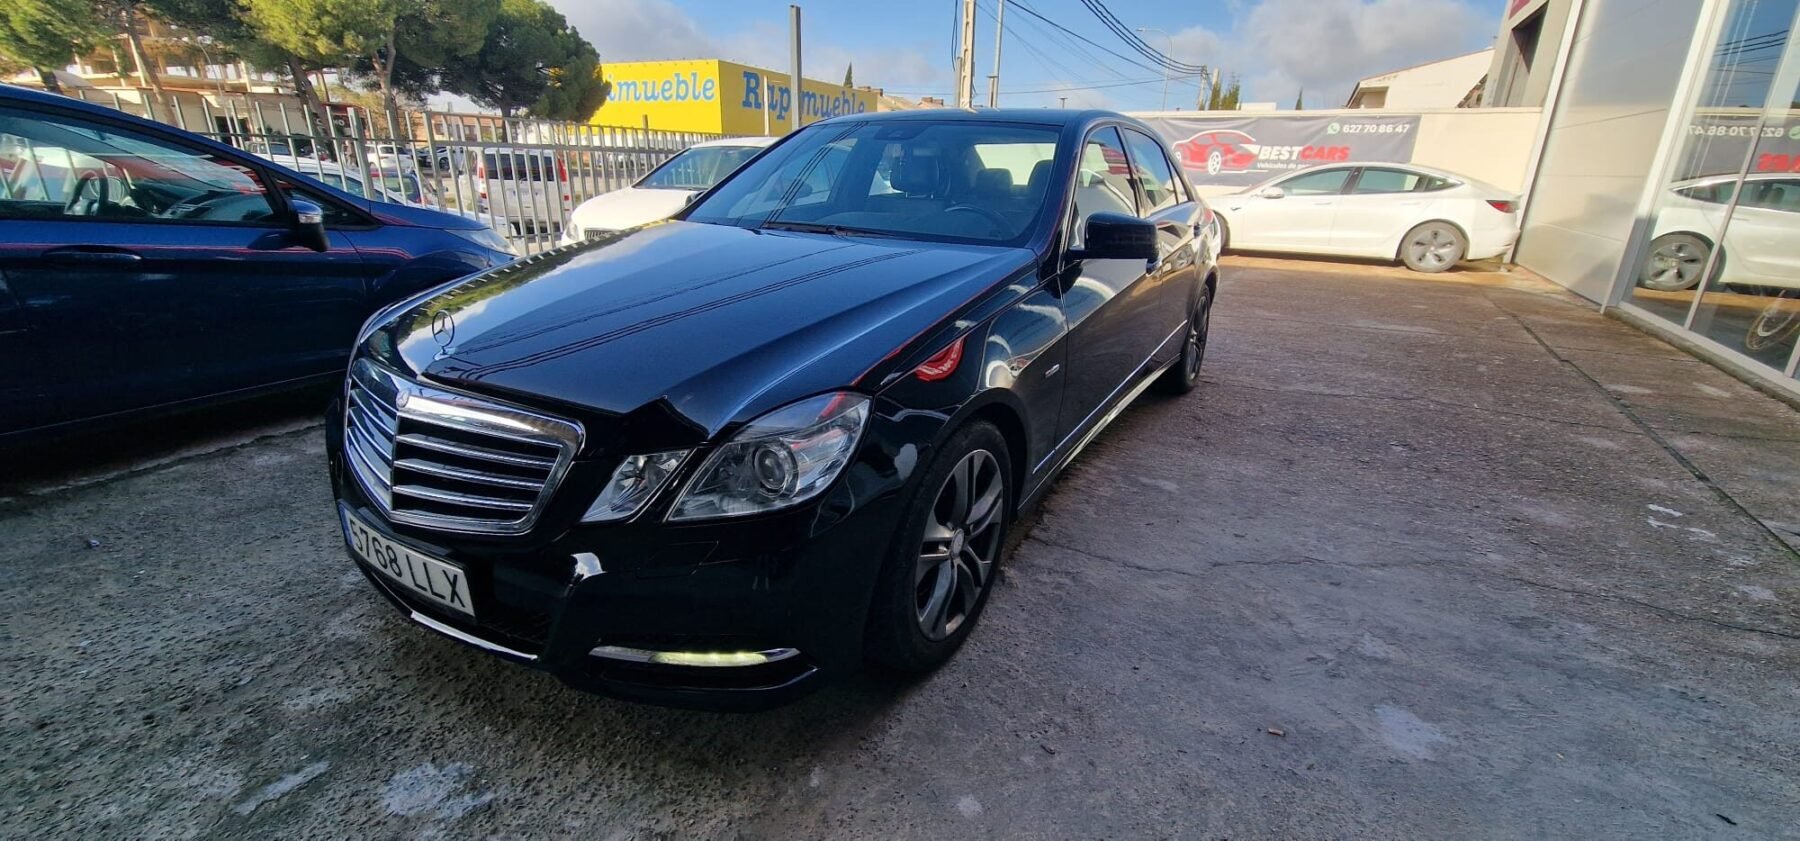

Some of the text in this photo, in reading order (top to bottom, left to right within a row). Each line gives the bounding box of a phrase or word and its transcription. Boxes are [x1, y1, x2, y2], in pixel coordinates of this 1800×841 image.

[1342, 124, 1361, 134] 627
[1363, 124, 1377, 134] 70
[1395, 123, 1411, 134] 47
[1258, 145, 1350, 161] BESTCARS
[350, 518, 466, 608] 5768 LLX
